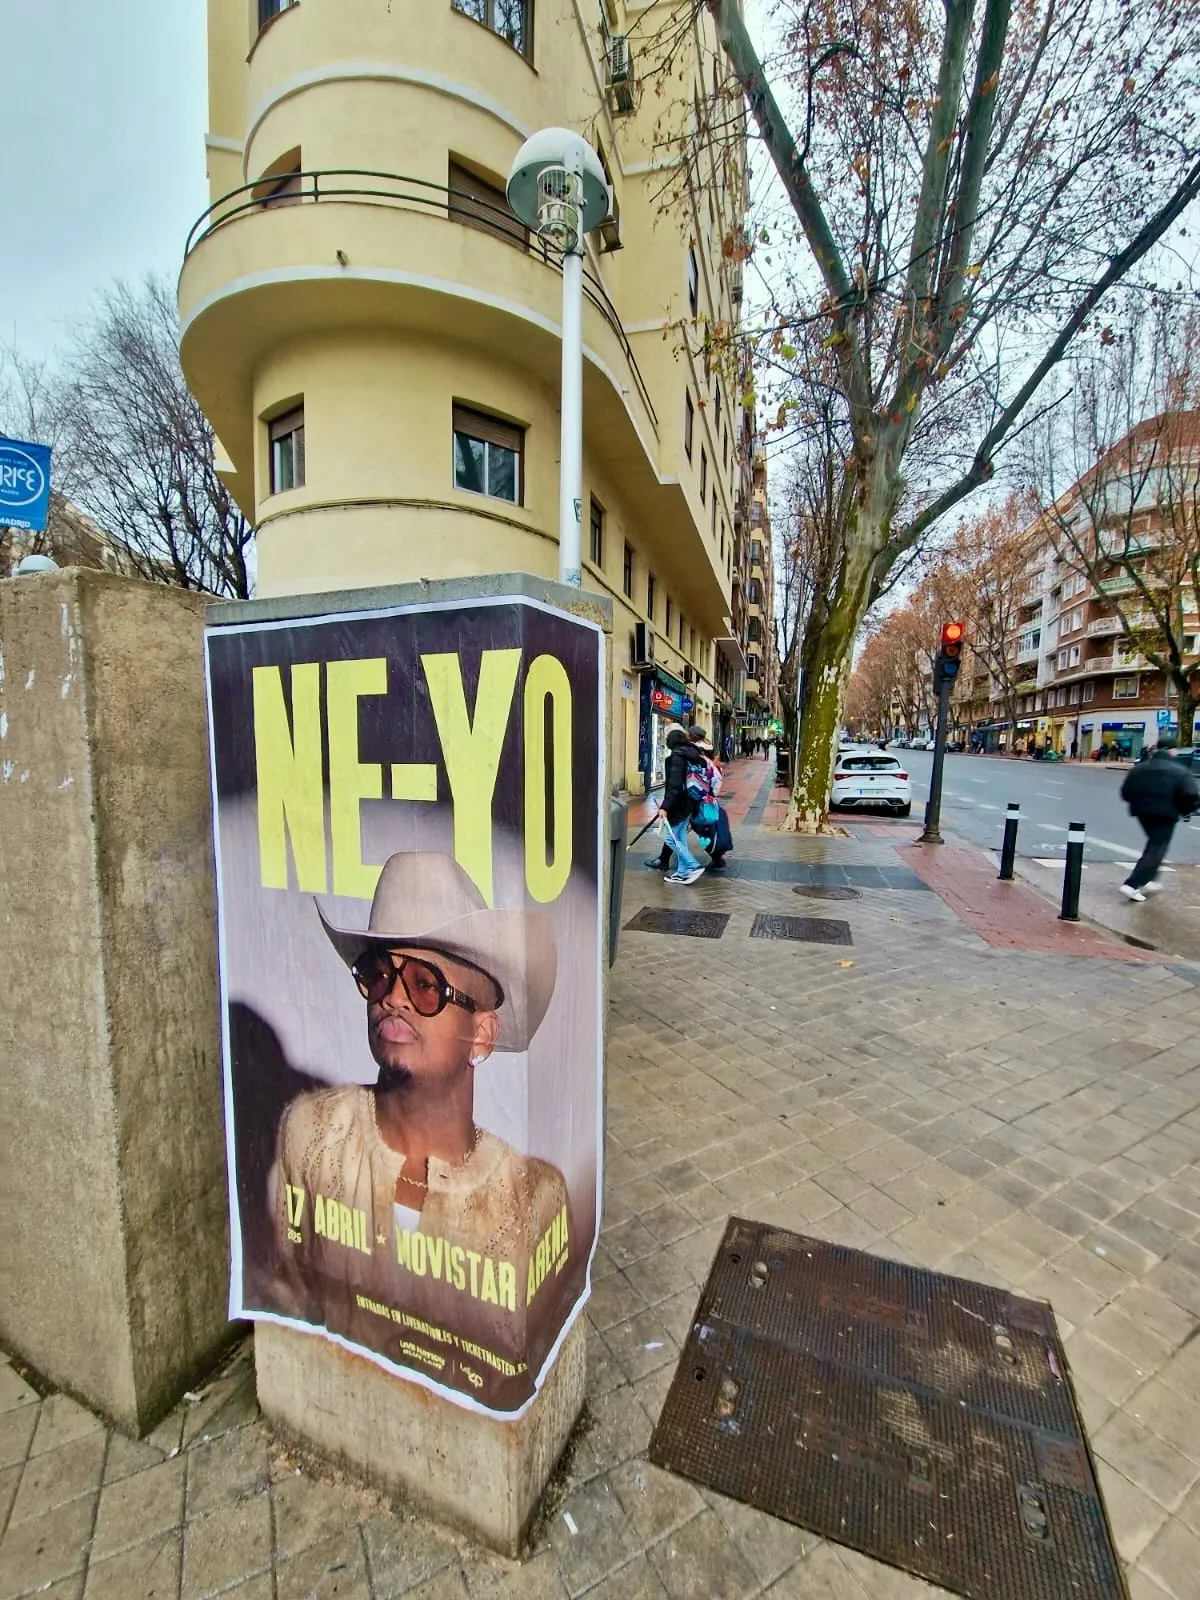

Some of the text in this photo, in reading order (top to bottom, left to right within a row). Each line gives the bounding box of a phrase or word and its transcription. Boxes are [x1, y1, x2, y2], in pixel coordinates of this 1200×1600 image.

[0, 464, 36, 491] RICE
[1159, 709, 1169, 720] P
[252, 648, 573, 909] NE-YO
[286, 1183, 569, 1312] 17 ABRIL MOVISTAR ARENA
[391, 1309, 401, 1324] EN
[453, 1335, 459, 1348] Y
